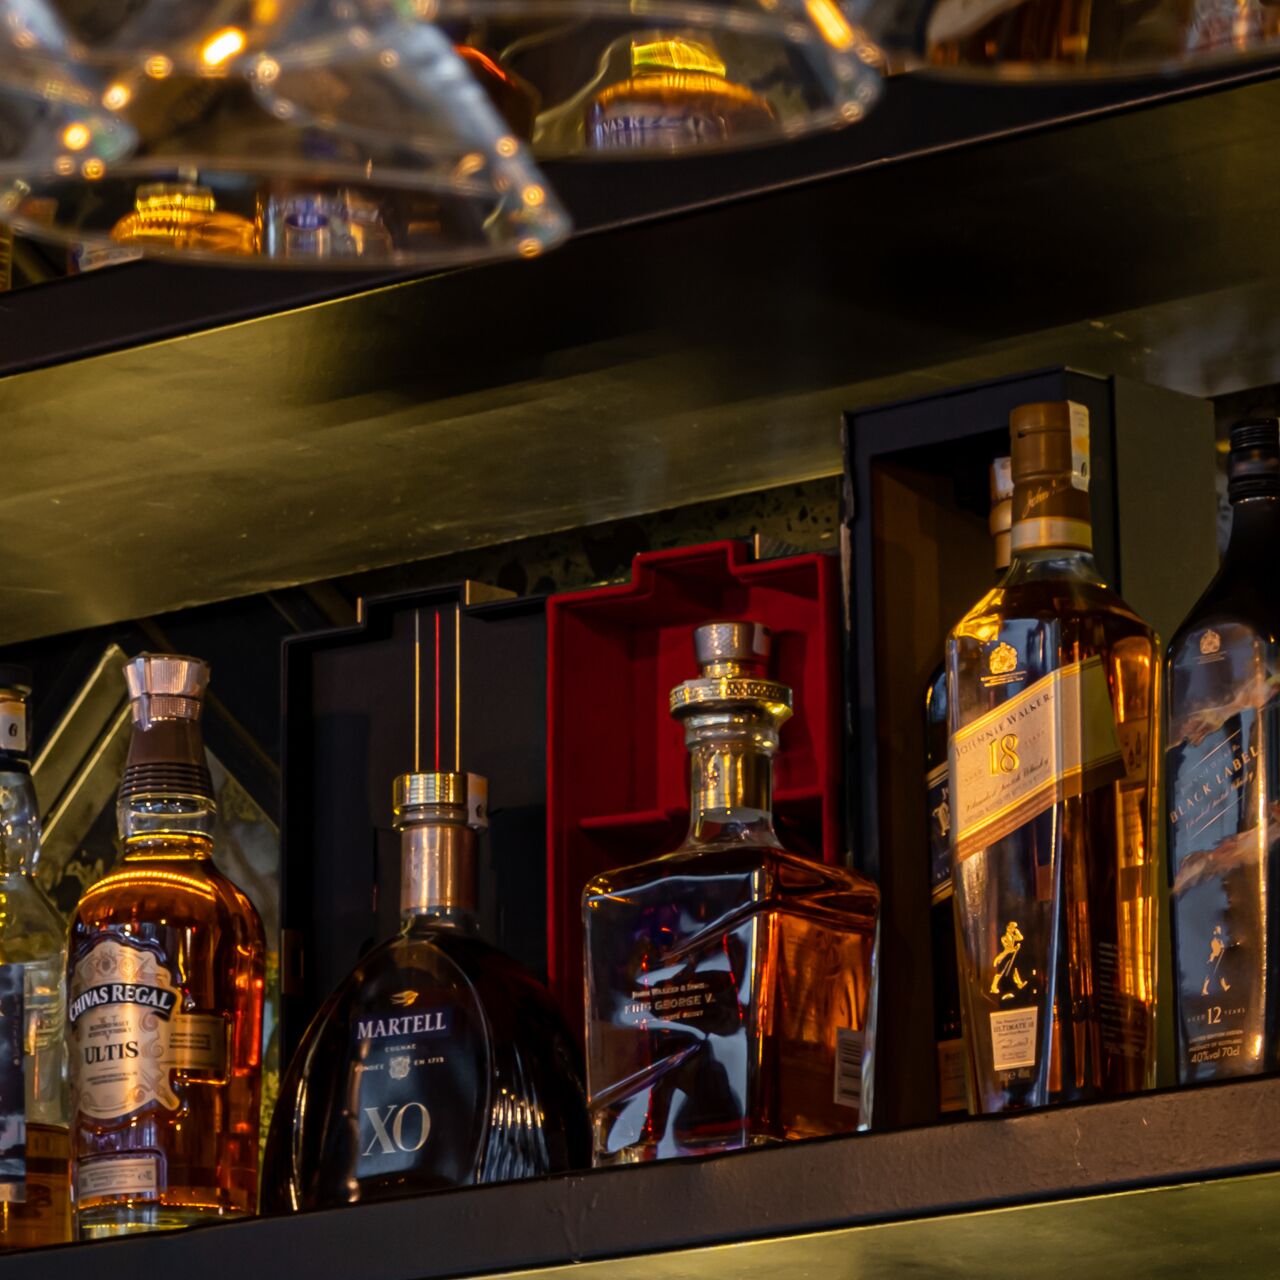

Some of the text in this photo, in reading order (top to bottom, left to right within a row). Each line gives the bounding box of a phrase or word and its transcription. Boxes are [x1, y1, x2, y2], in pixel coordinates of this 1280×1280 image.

[955, 693, 1051, 762] JOHNNIE WALKER
[988, 733, 1020, 777] 18
[1169, 782, 1212, 824] BLACK
[1215, 745, 1259, 785] LABEL
[69, 983, 172, 1022] CHIVAS REGAL
[1207, 1006, 1222, 1025] 12
[356, 1011, 448, 1040] MARTELL
[84, 1040, 139, 1065] ULTIS
[384, 1043, 417, 1053] COGNAC
[361, 1101, 432, 1158] XO
